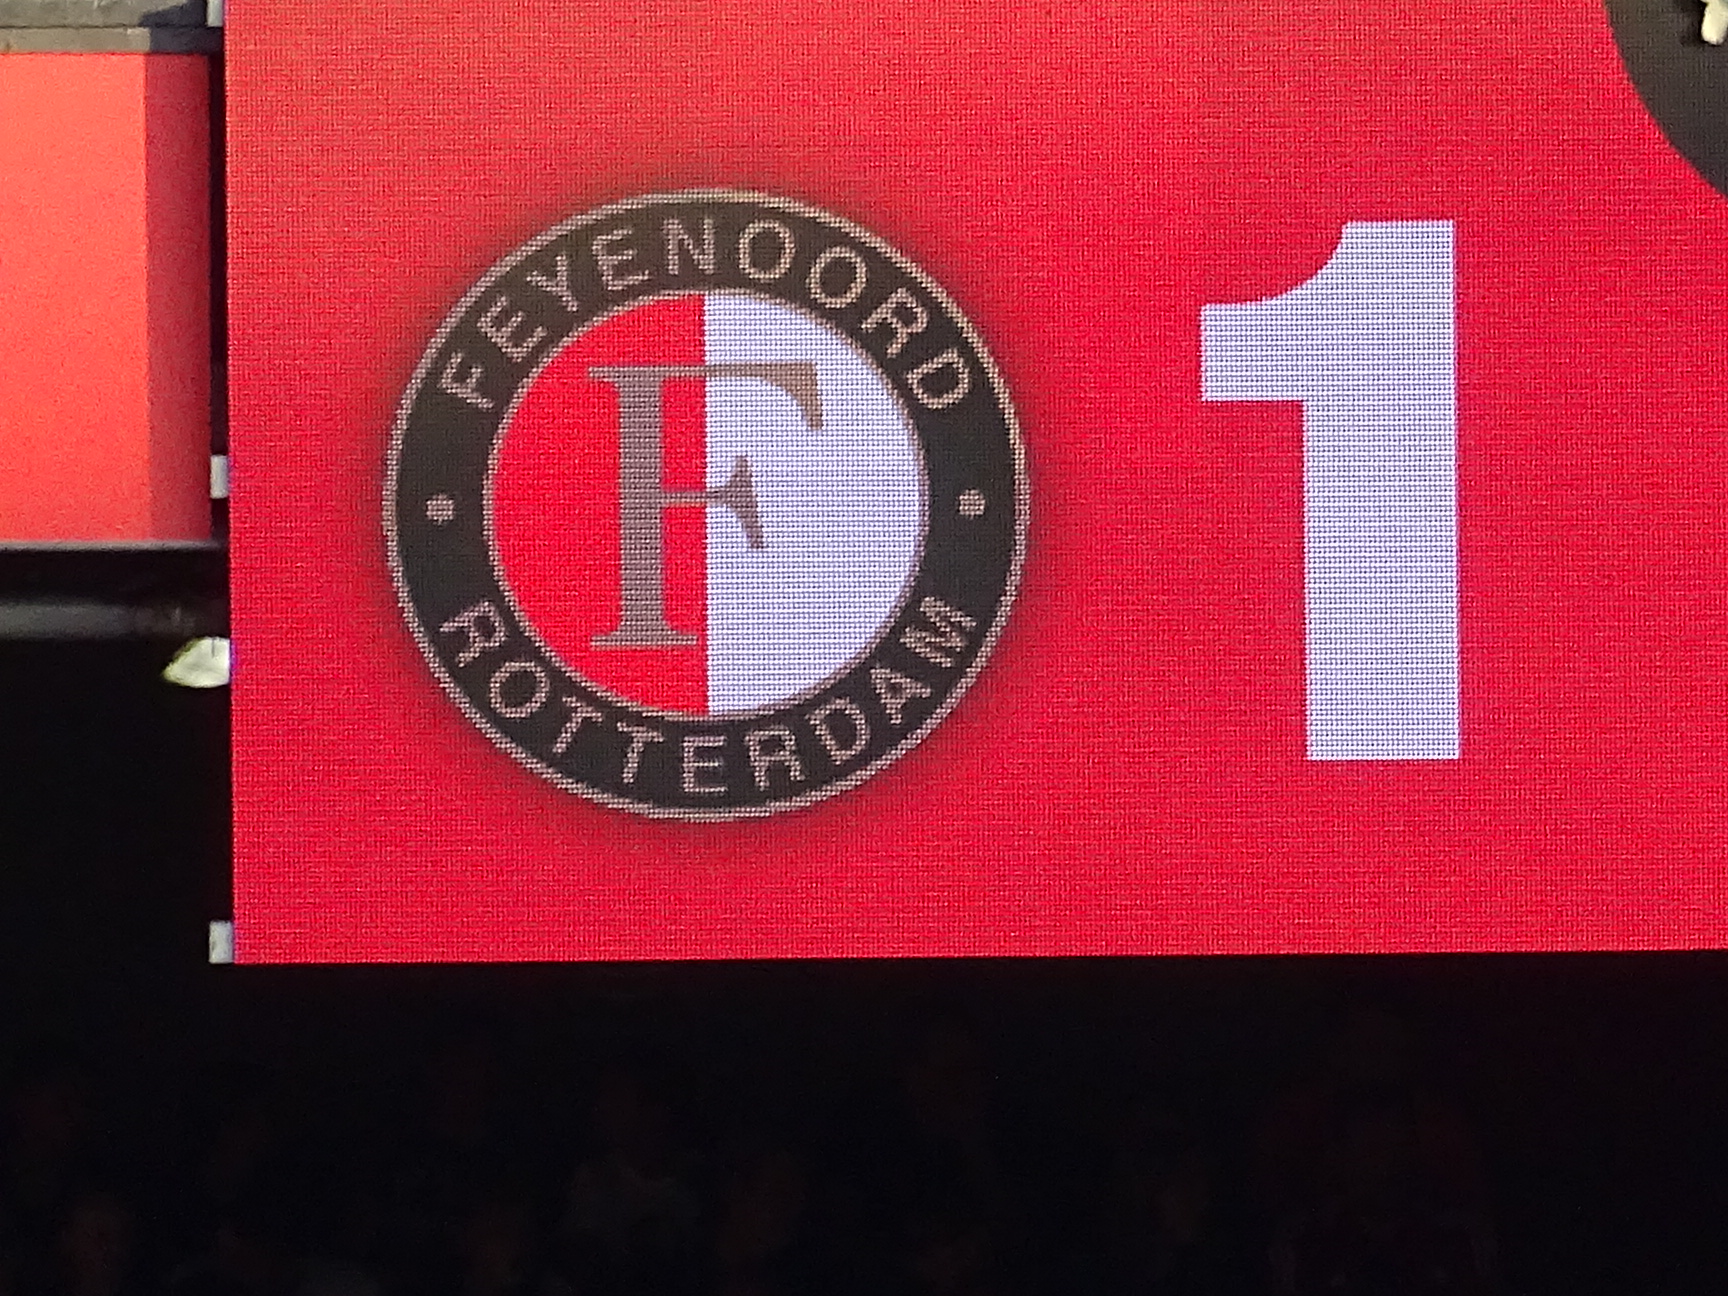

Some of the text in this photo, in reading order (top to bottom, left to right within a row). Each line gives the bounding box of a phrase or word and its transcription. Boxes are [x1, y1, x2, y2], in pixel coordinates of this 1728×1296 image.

[437, 217, 971, 410] FEYENOORD
[1200, 219, 1461, 761] 1
[439, 595, 979, 794] ROTTERDAM
